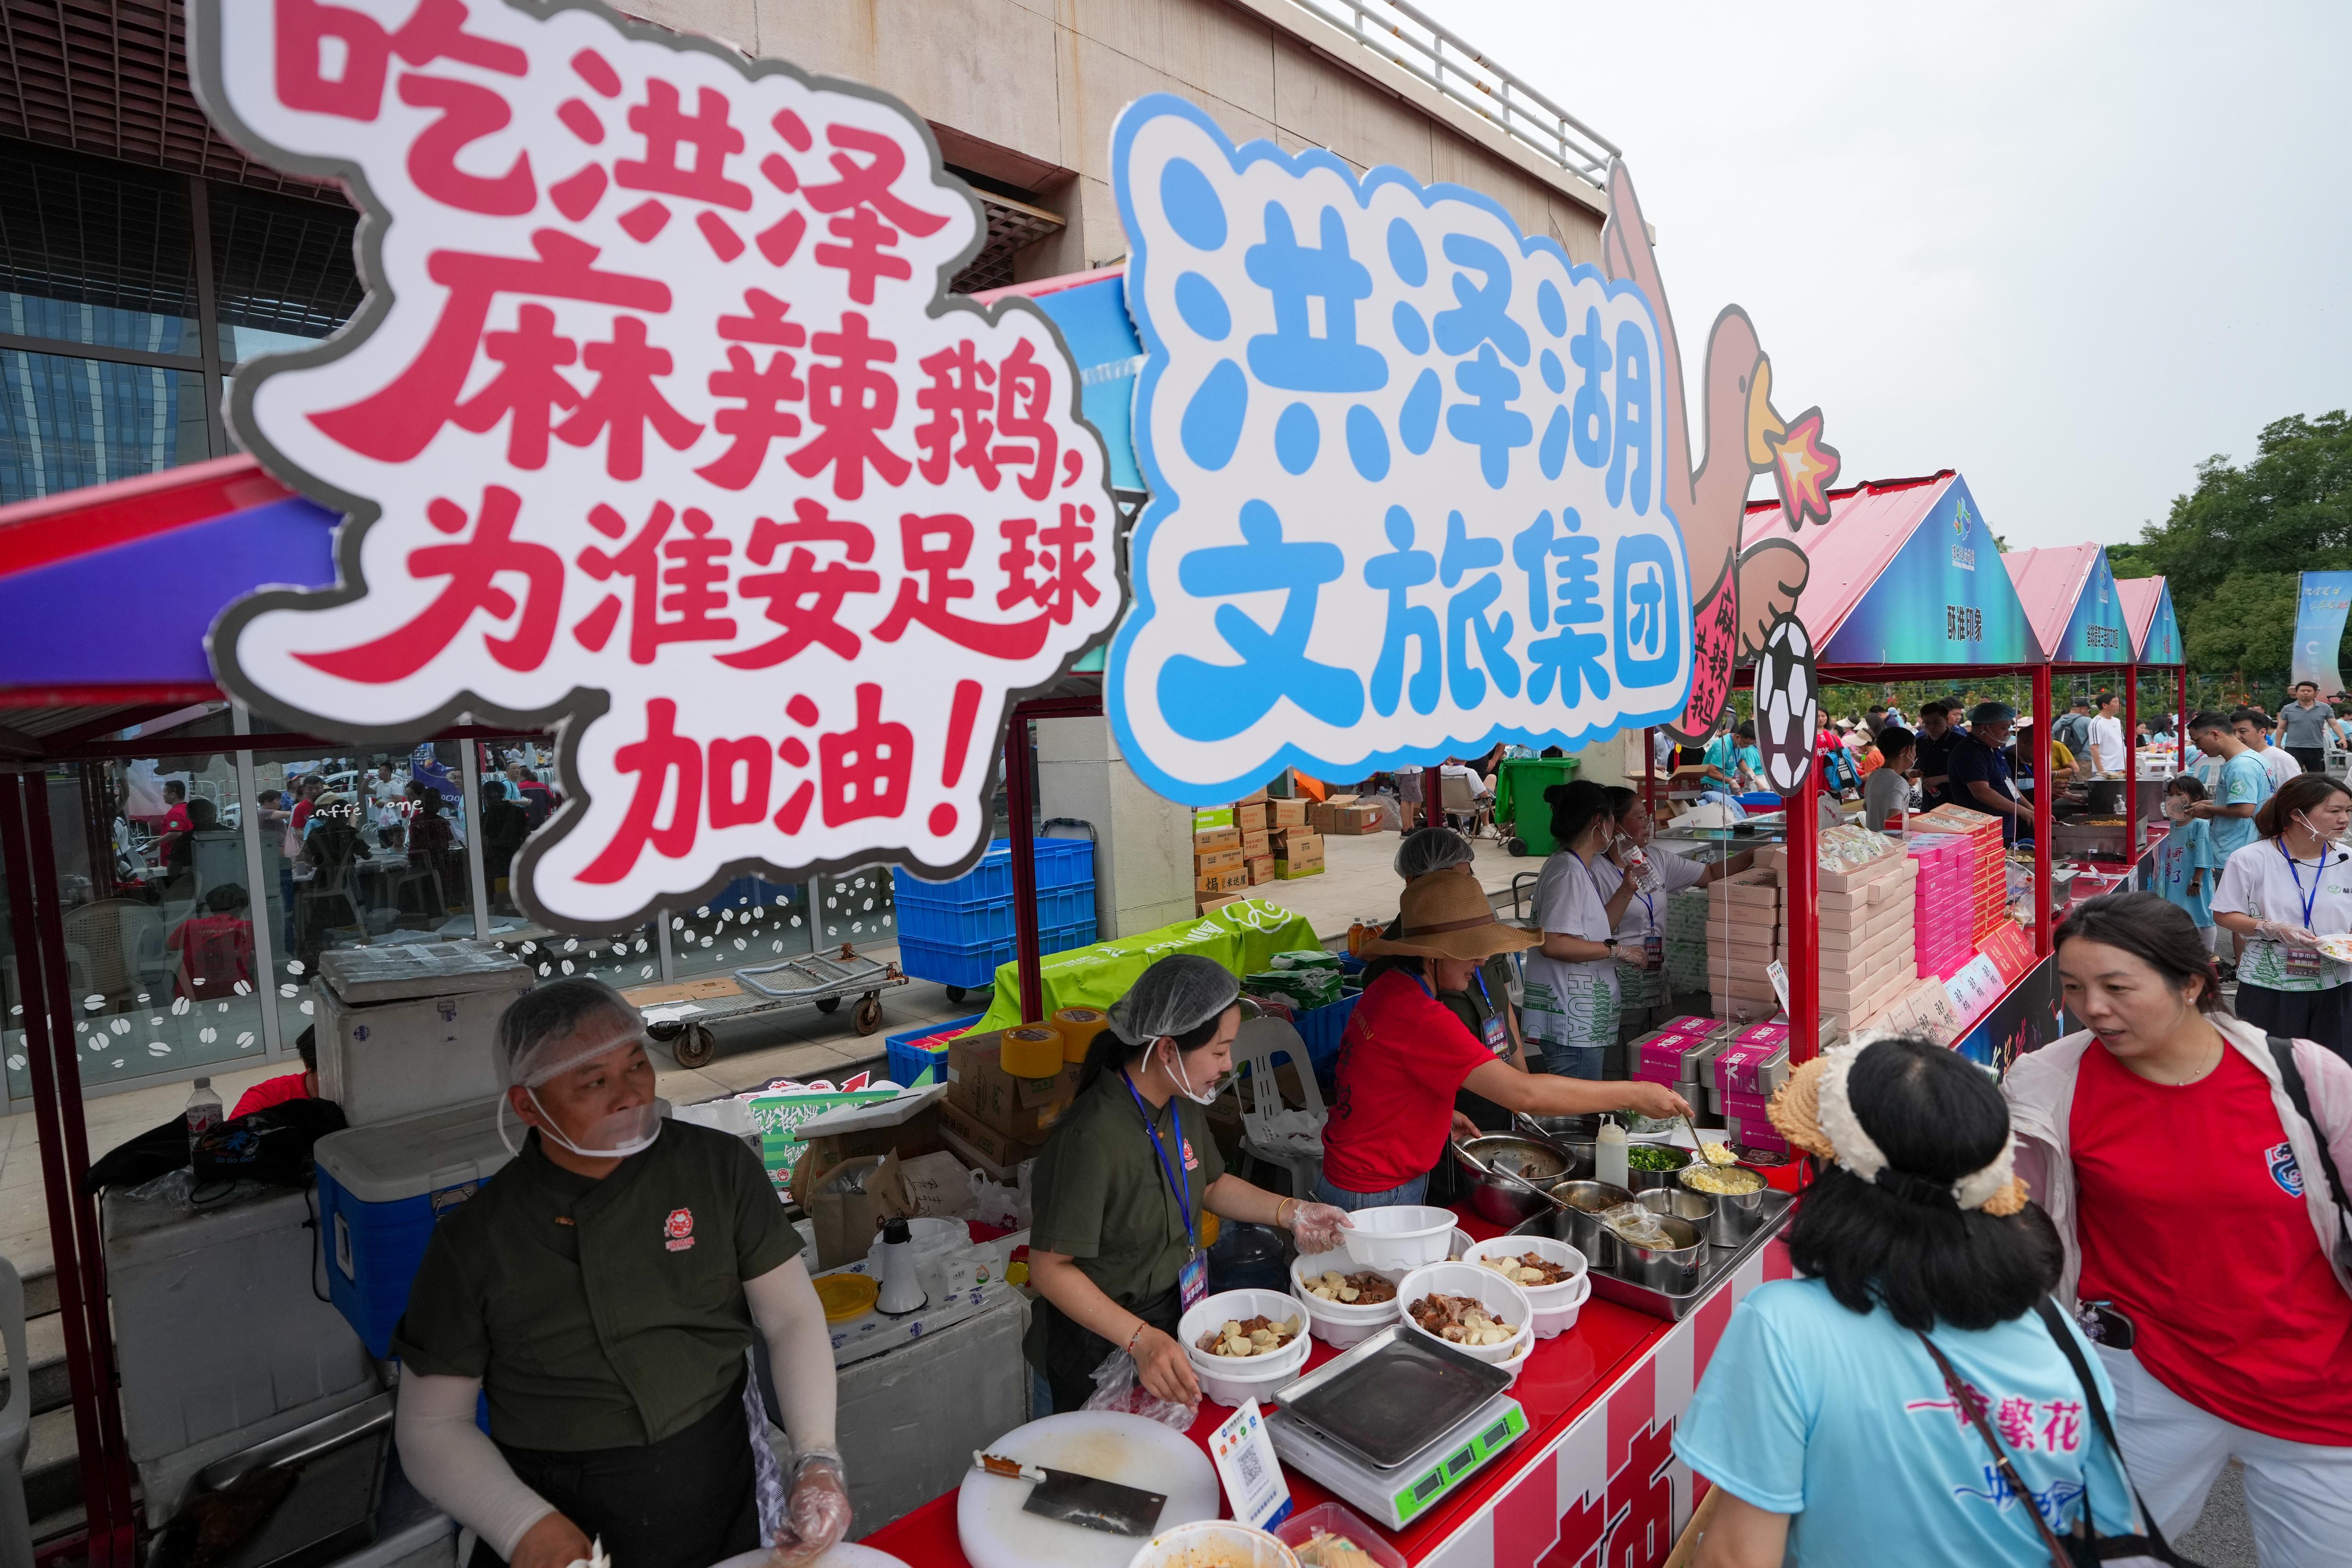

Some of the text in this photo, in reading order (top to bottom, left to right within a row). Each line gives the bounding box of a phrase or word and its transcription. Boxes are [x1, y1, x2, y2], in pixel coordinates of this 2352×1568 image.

[275, 0, 950, 305] 吃洪泽
[1160, 158, 1657, 516] 洪泽湖
[291, 485, 1101, 685] 为淮安足球
[1157, 499, 1680, 742] 文旅集团
[1947, 604, 1982, 643] 酥淮印象
[309, 803, 362, 818] affé
[574, 679, 983, 885] 加油！
[1226, 875, 1247, 887] 米达屋
[1489, 1032, 1504, 1044] 赛事市集
